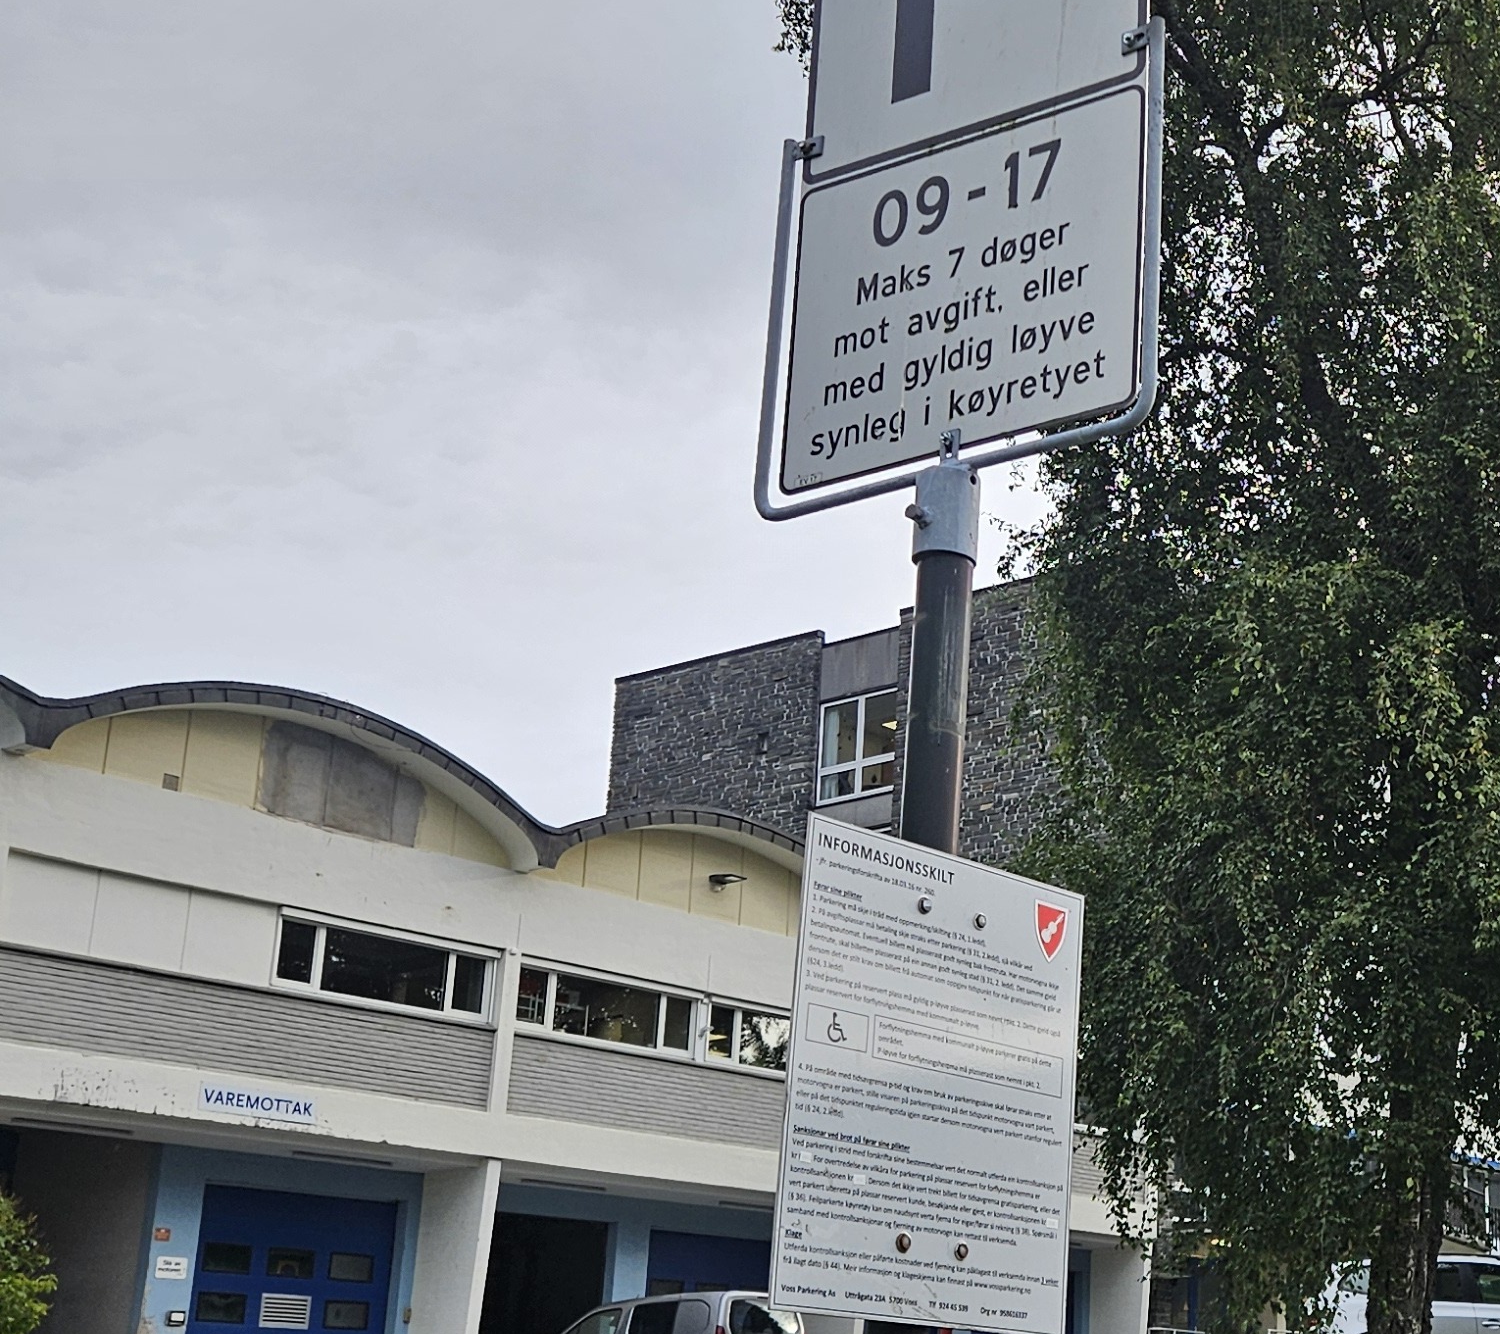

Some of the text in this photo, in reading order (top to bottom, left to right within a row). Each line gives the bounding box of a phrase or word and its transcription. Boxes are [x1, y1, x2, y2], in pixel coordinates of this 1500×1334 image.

[855, 222, 1071, 306] Maks 7 døger
[833, 264, 1090, 358] mot avgift, eller
[823, 311, 1095, 406] med gyldig løyve
[810, 350, 1106, 459] synleg i køyretyet
[818, 832, 955, 885] INFORMASJONSSKILT
[204, 1088, 313, 1117] VAREMOTTAK
